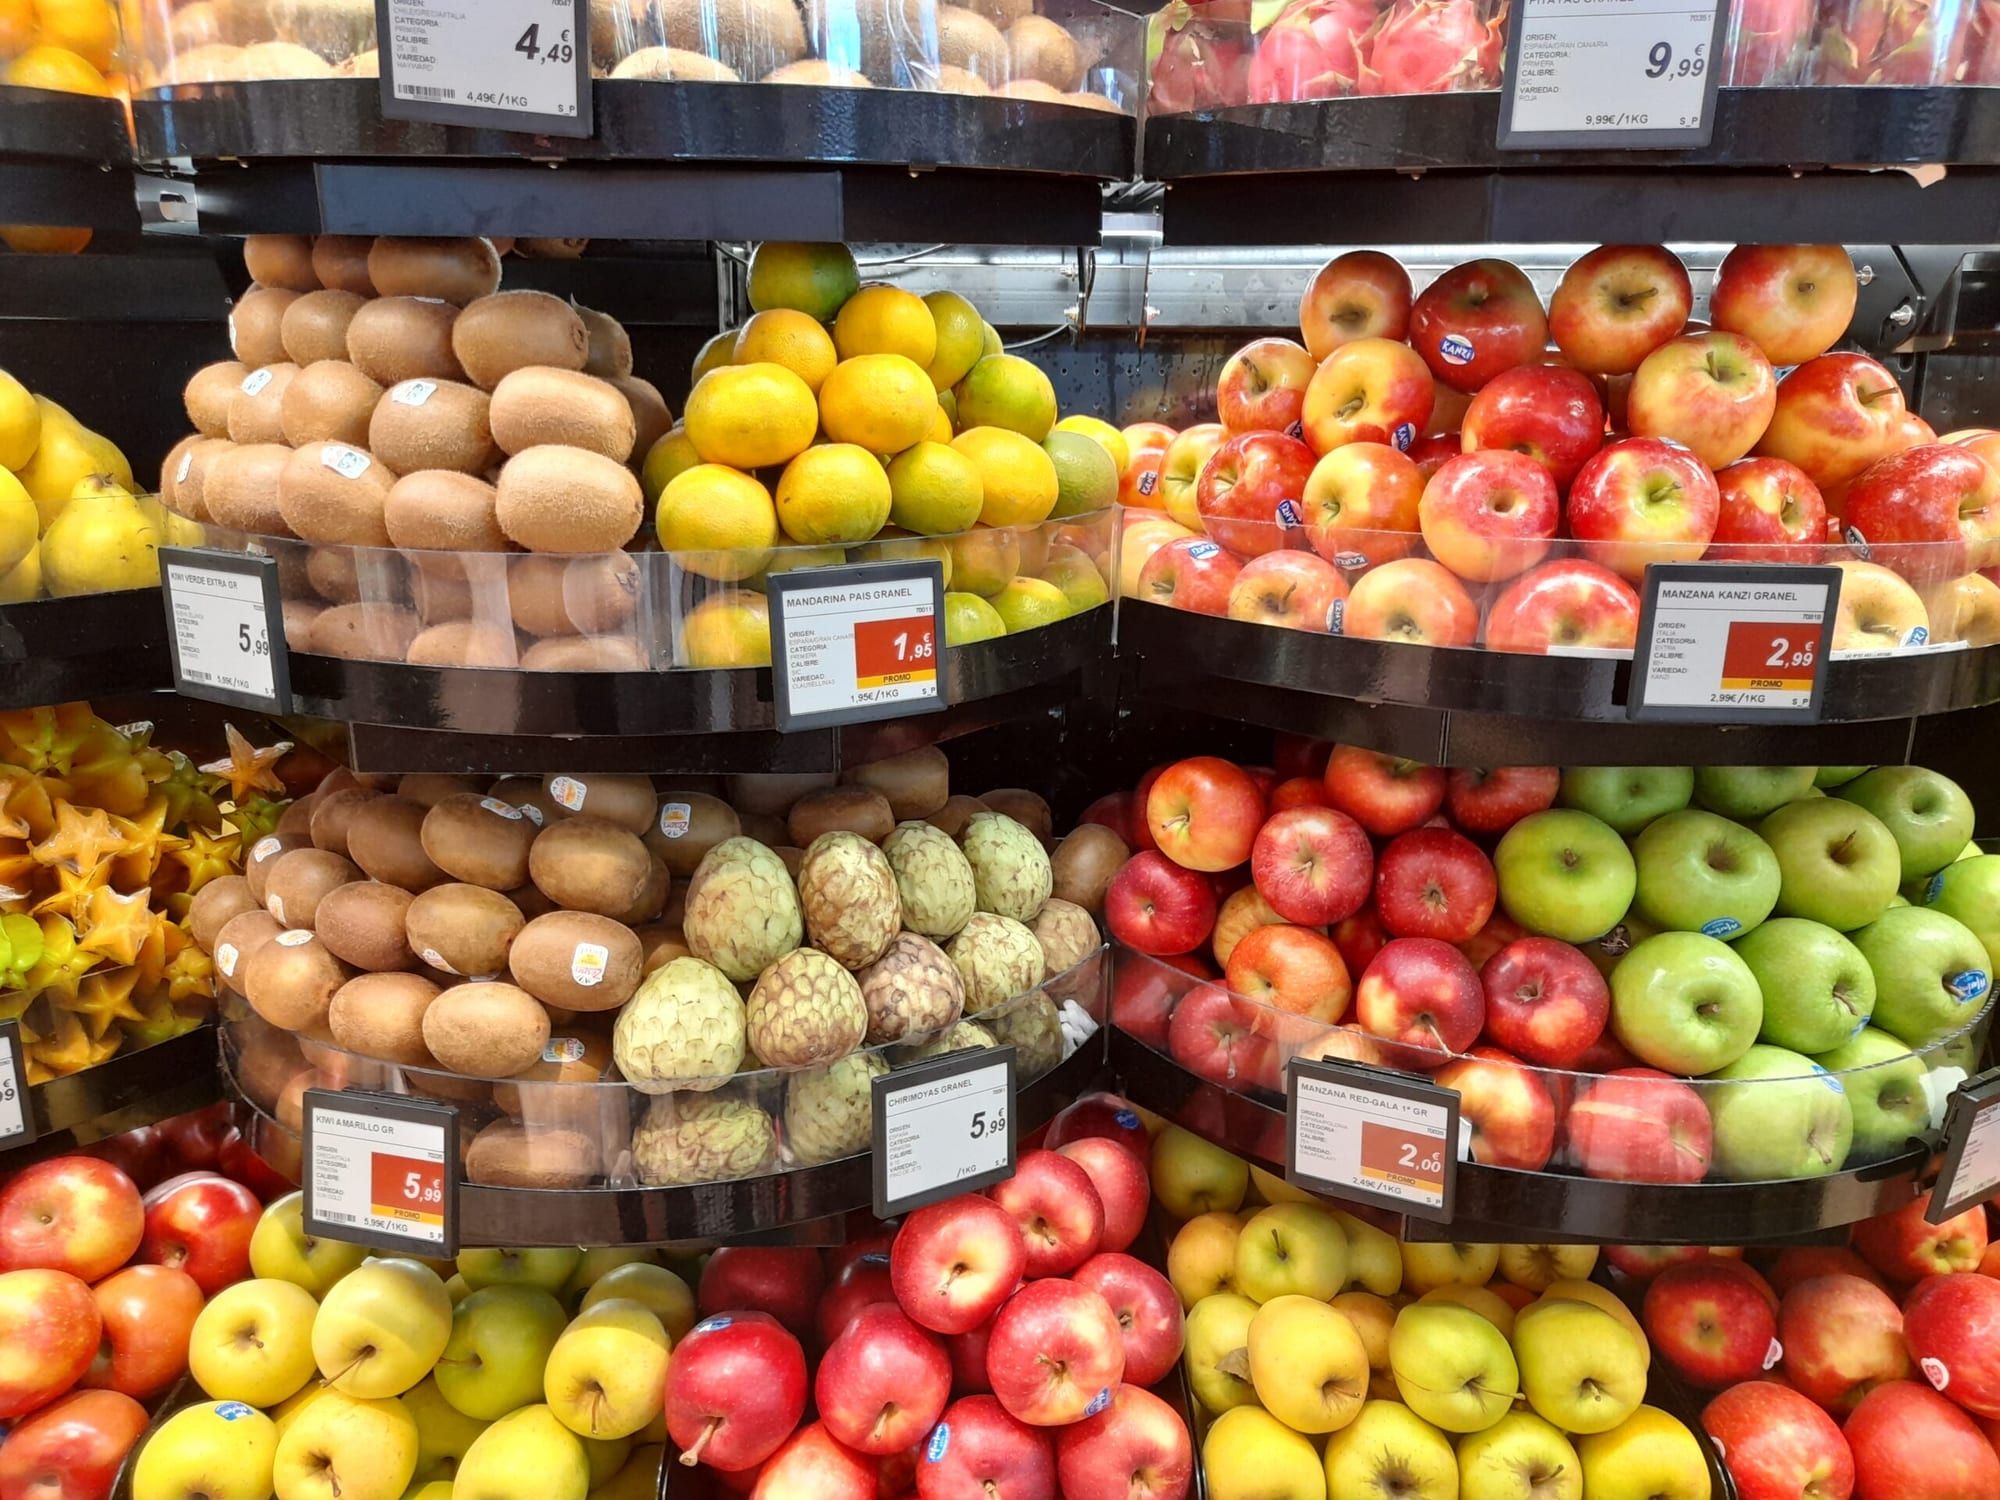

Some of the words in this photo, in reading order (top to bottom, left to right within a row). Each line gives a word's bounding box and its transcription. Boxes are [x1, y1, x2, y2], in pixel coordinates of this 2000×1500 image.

[1441, 342, 1473, 360] KANZI
[787, 594, 846, 607] MANDARINA
[849, 591, 871, 602] PAIS
[874, 588, 912, 600] GRANEL
[1662, 590, 1714, 599] MANZANA
[1719, 591, 1751, 600] KANZI
[1754, 591, 1798, 601] GRANEL
[883, 673, 911, 683] PROMO
[1750, 680, 1783, 688] PROMO
[888, 1088, 939, 1107] CHIRIMOYAS
[941, 1079, 973, 1094] GRANEL
[1301, 1083, 1346, 1099] MANZANA
[1349, 1094, 1399, 1112] RED-GALA
[1413, 1107, 1428, 1117] GR
[316, 1115, 335, 1125] KIWI
[337, 1119, 380, 1132] AMARILLO
[381, 1125, 394, 1135] GR
[1387, 1174, 1416, 1185] PROMO
[394, 1209, 421, 1220] PROMO
